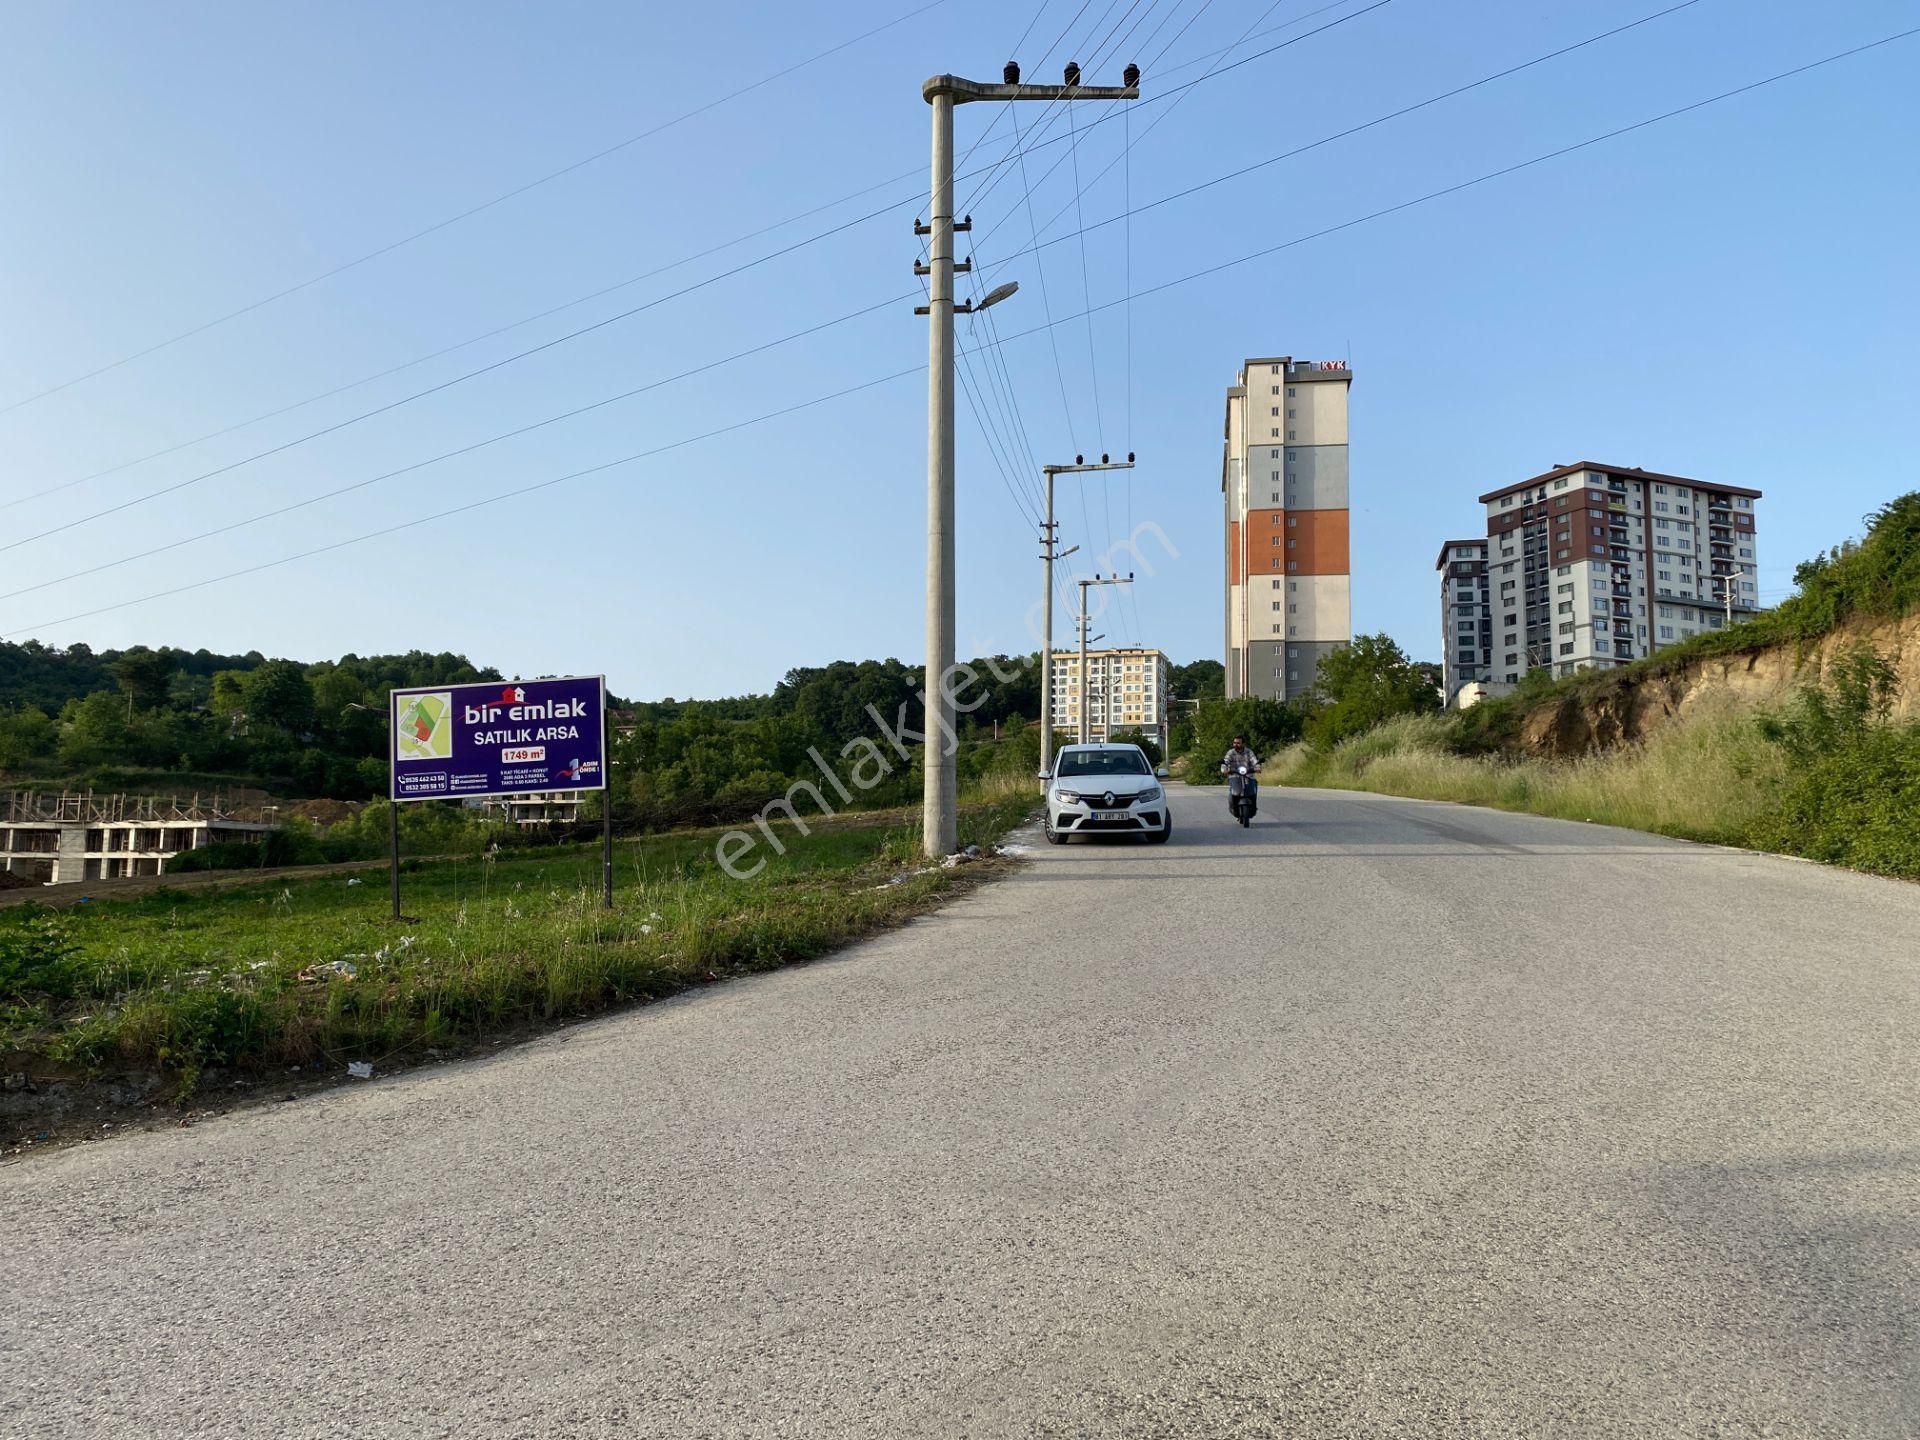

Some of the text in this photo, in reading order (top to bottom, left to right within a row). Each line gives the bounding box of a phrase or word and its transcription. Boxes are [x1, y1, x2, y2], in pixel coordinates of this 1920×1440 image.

[1321, 361, 1346, 371] KYK
[465, 698, 587, 725] bir emlak
[474, 725, 579, 746] SATILIK ARSA
[503, 751, 528, 761] 1749
